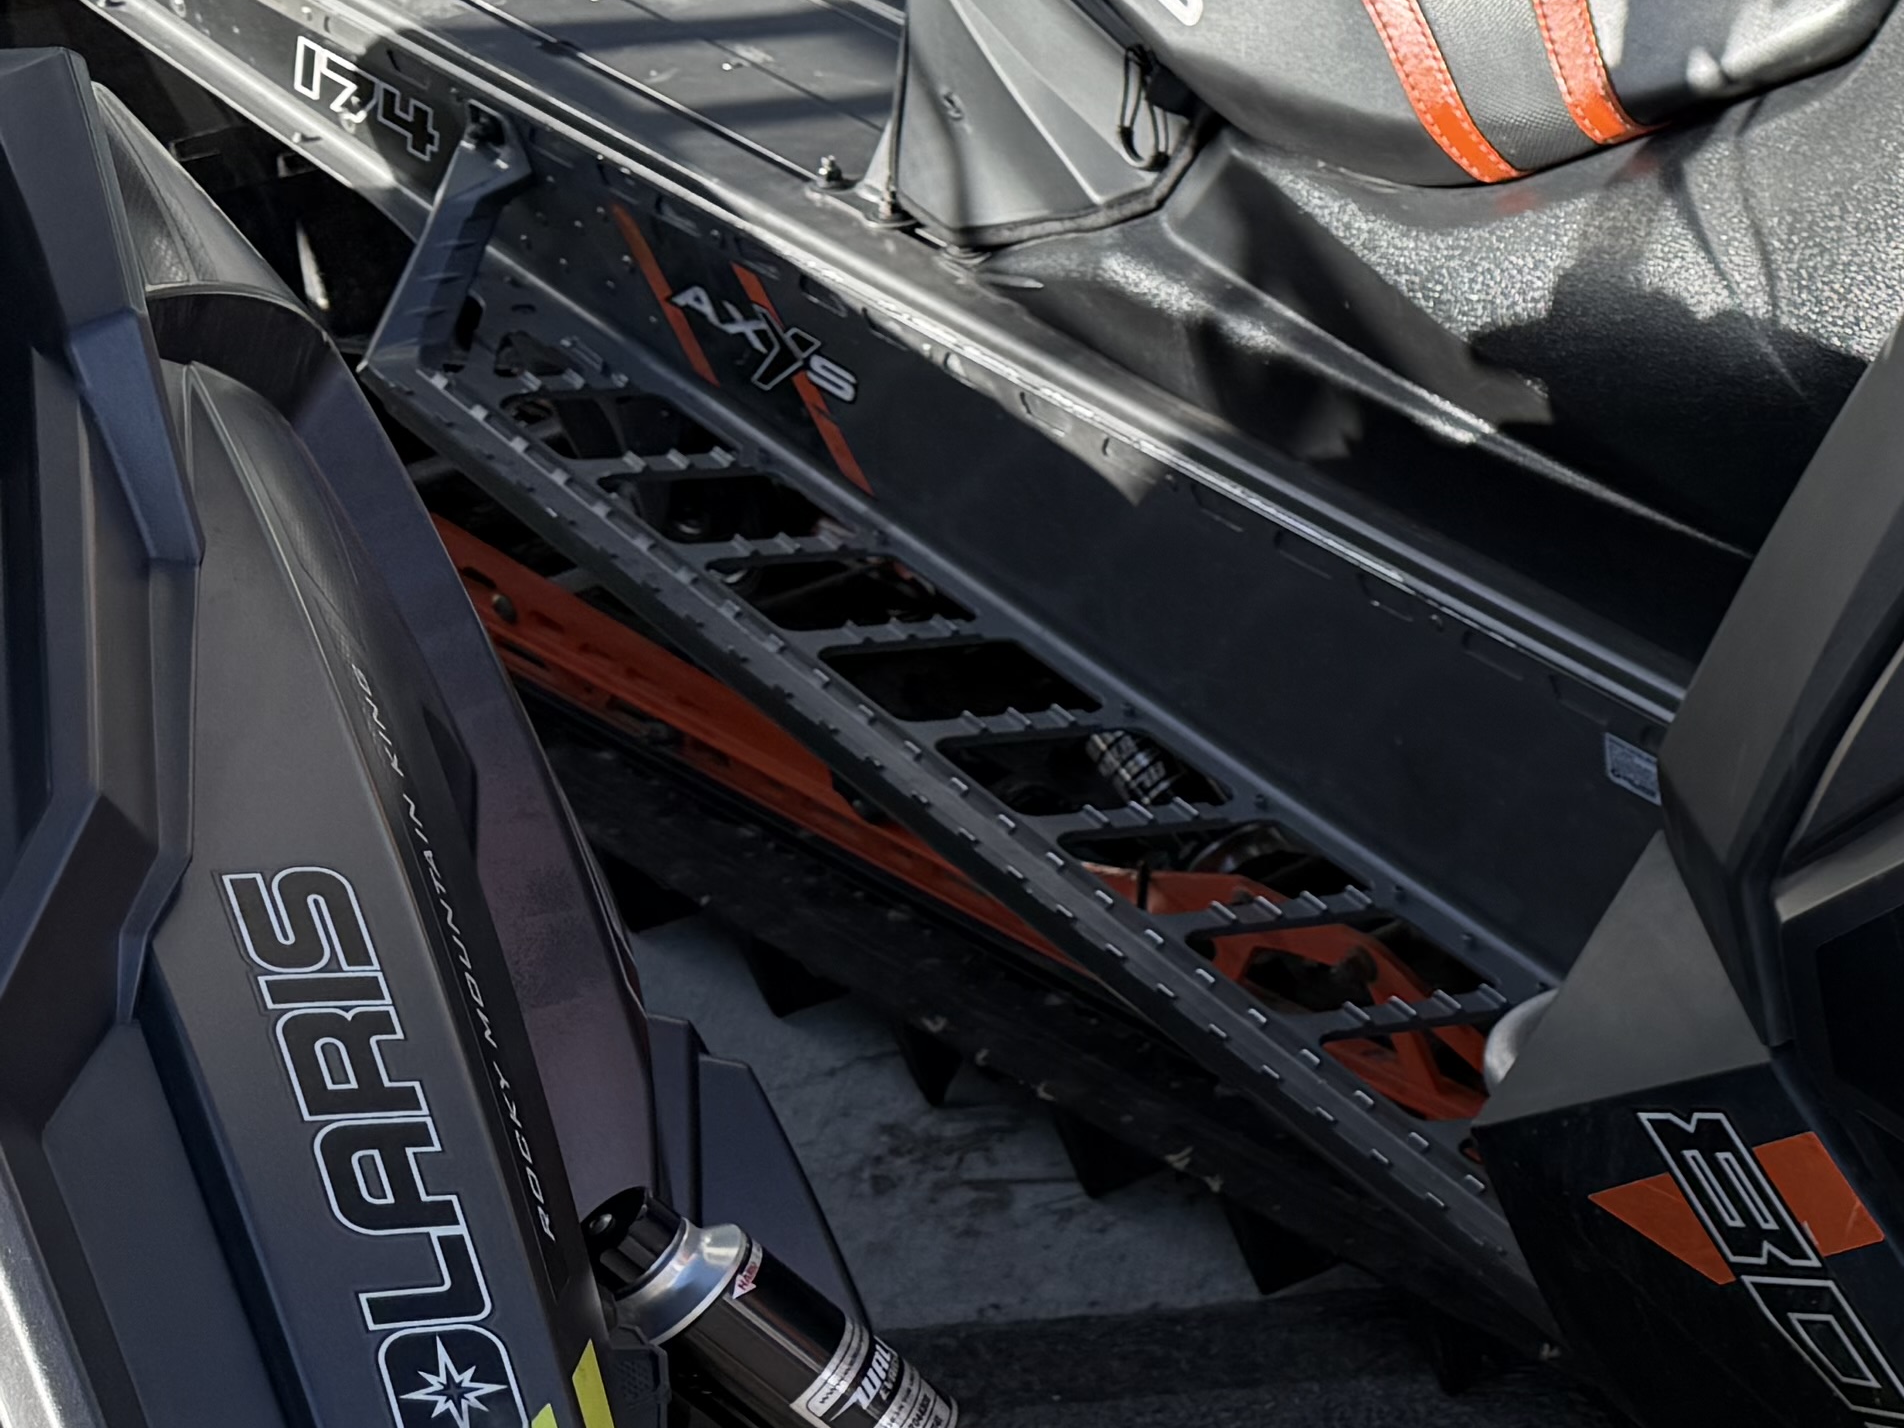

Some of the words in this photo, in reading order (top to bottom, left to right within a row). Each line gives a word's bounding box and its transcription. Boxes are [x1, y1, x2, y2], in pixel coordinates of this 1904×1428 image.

[294, 34, 440, 162] 174
[671, 285, 859, 404] AXYS
[352, 663, 404, 777] KING
[402, 792, 498, 1049] MOUNTAIN
[494, 1060, 556, 1243] ROCKY
